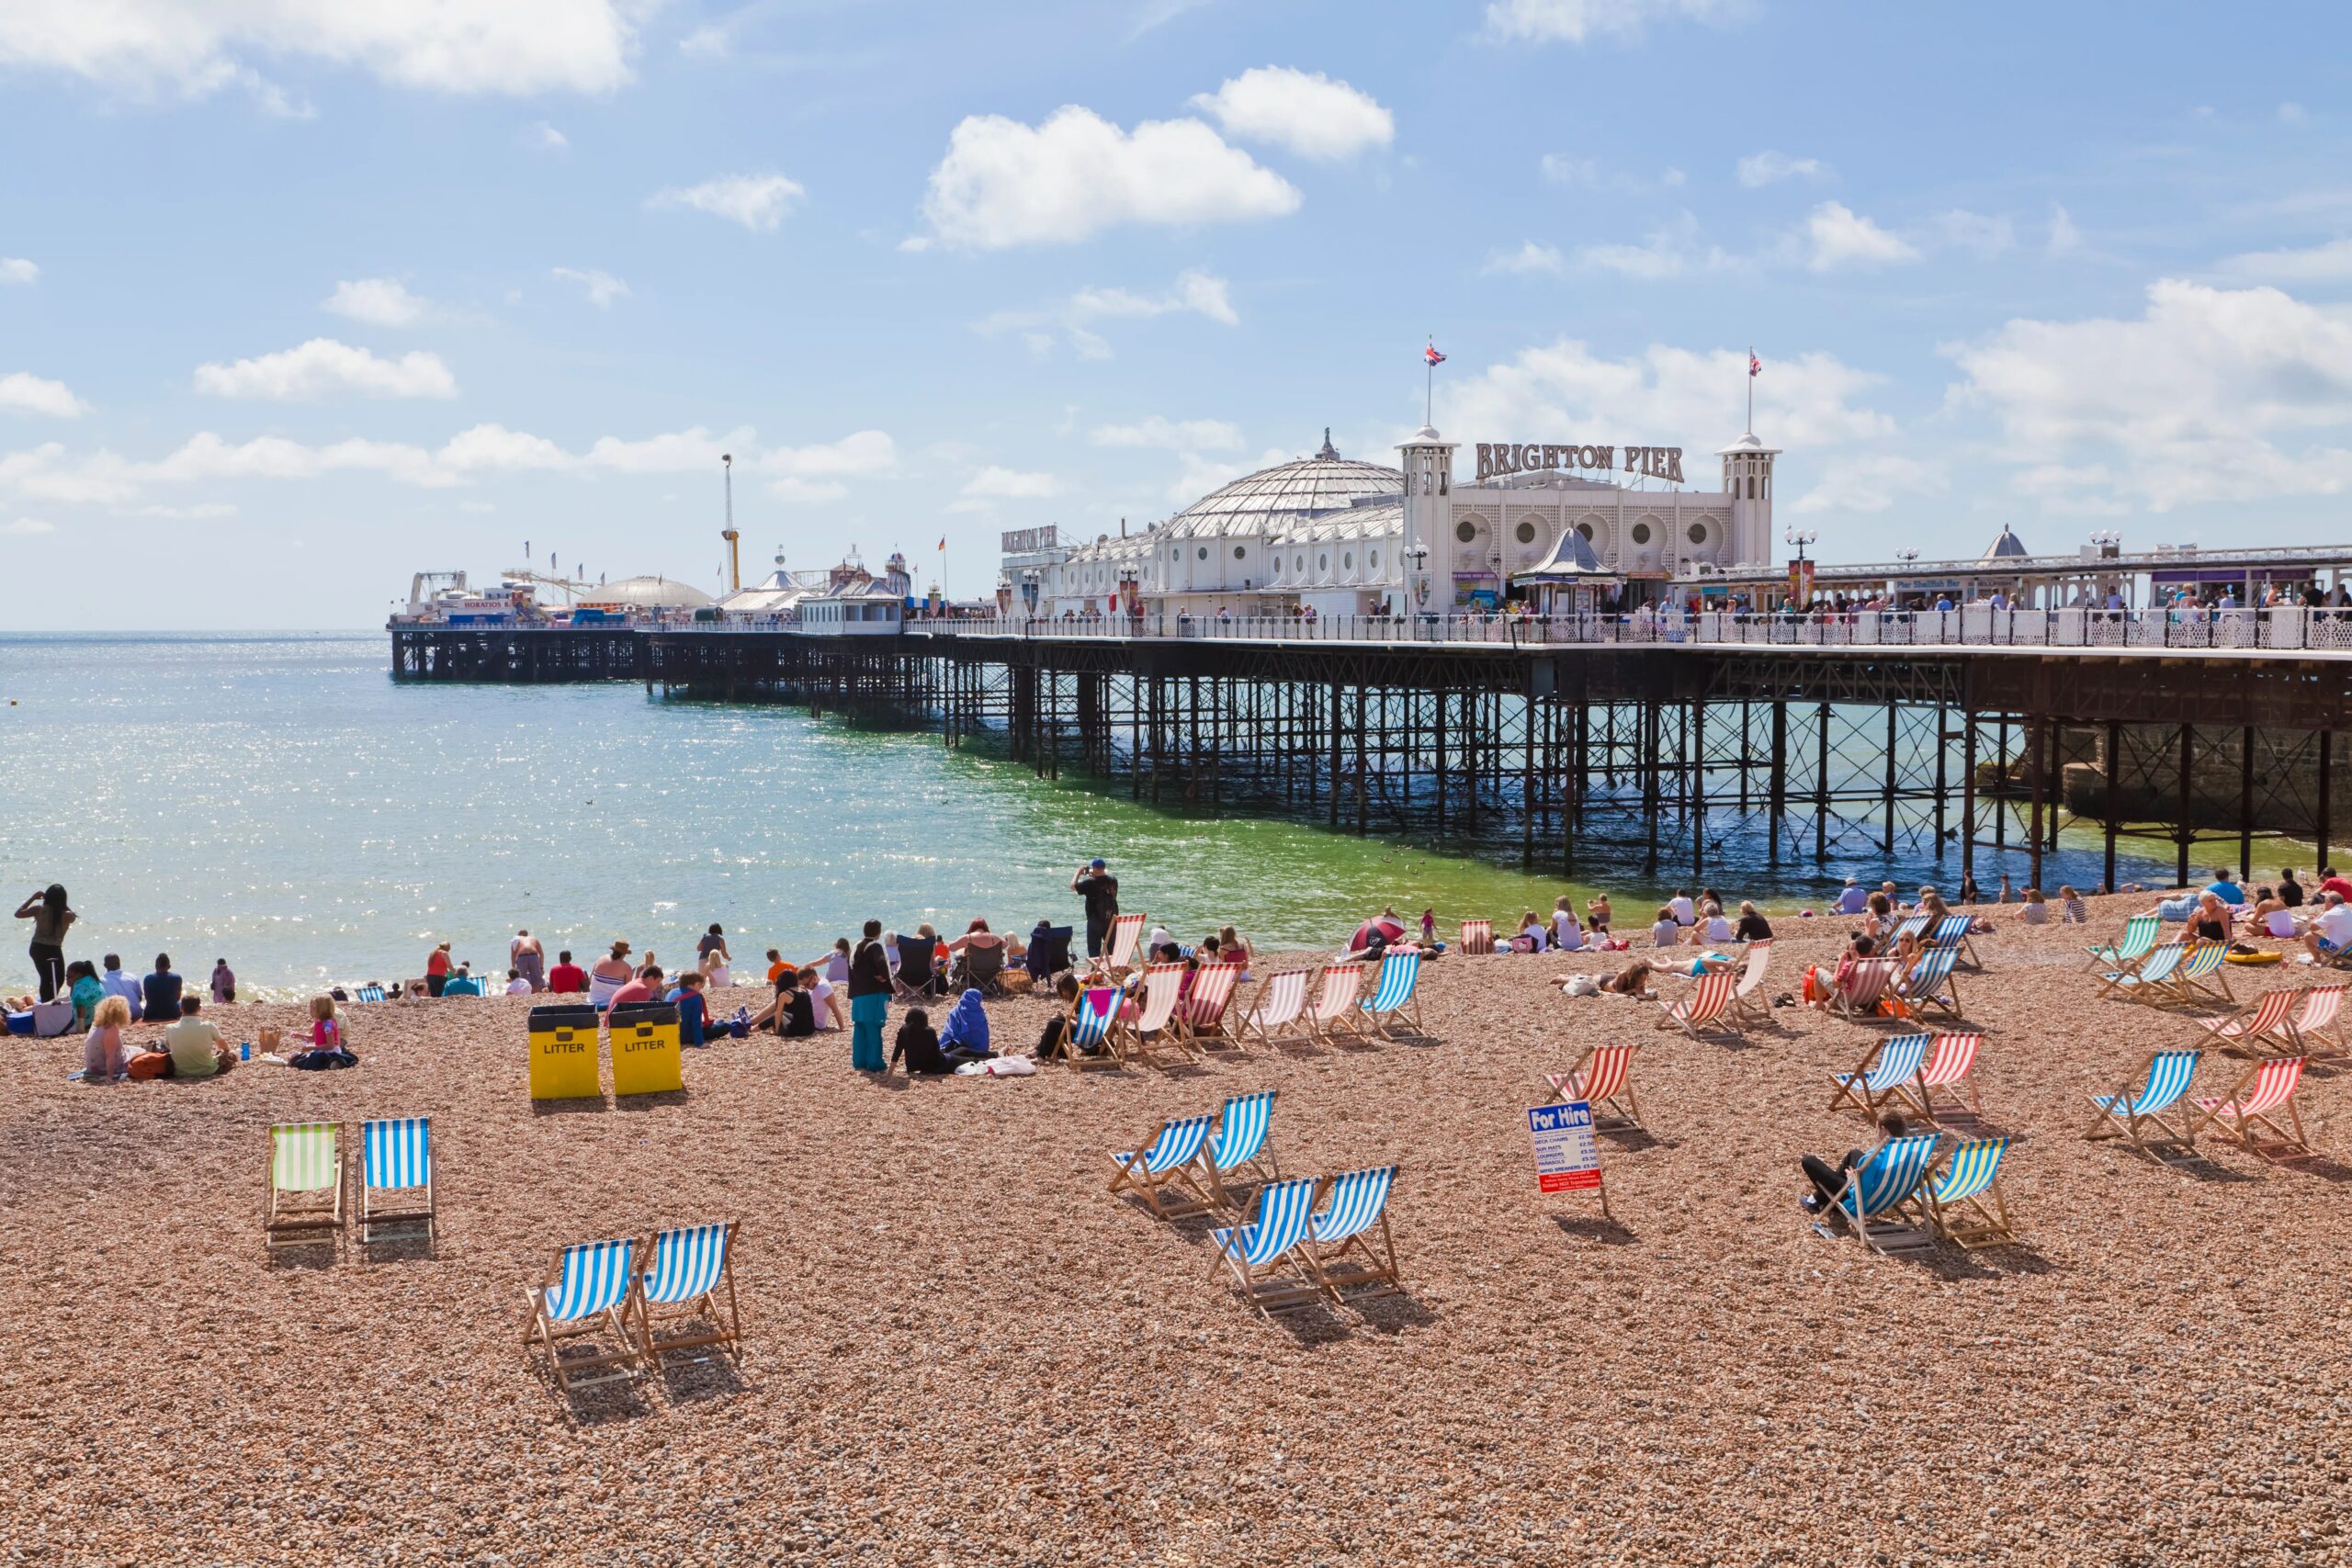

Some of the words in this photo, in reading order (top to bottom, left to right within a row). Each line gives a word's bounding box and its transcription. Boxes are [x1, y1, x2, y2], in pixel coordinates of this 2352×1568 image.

[1476, 443, 1614, 479] BRIGHTON
[1624, 446, 1685, 483] PIER
[1896, 581, 1911, 589] Pier
[1913, 580, 1945, 588] Shellfish
[1947, 579, 1961, 587] Bar
[544, 1043, 585, 1055] LITTER
[625, 1040, 665, 1053] LITTER
[1531, 1111, 1555, 1130] For
[1557, 1106, 1590, 1127] Hire
